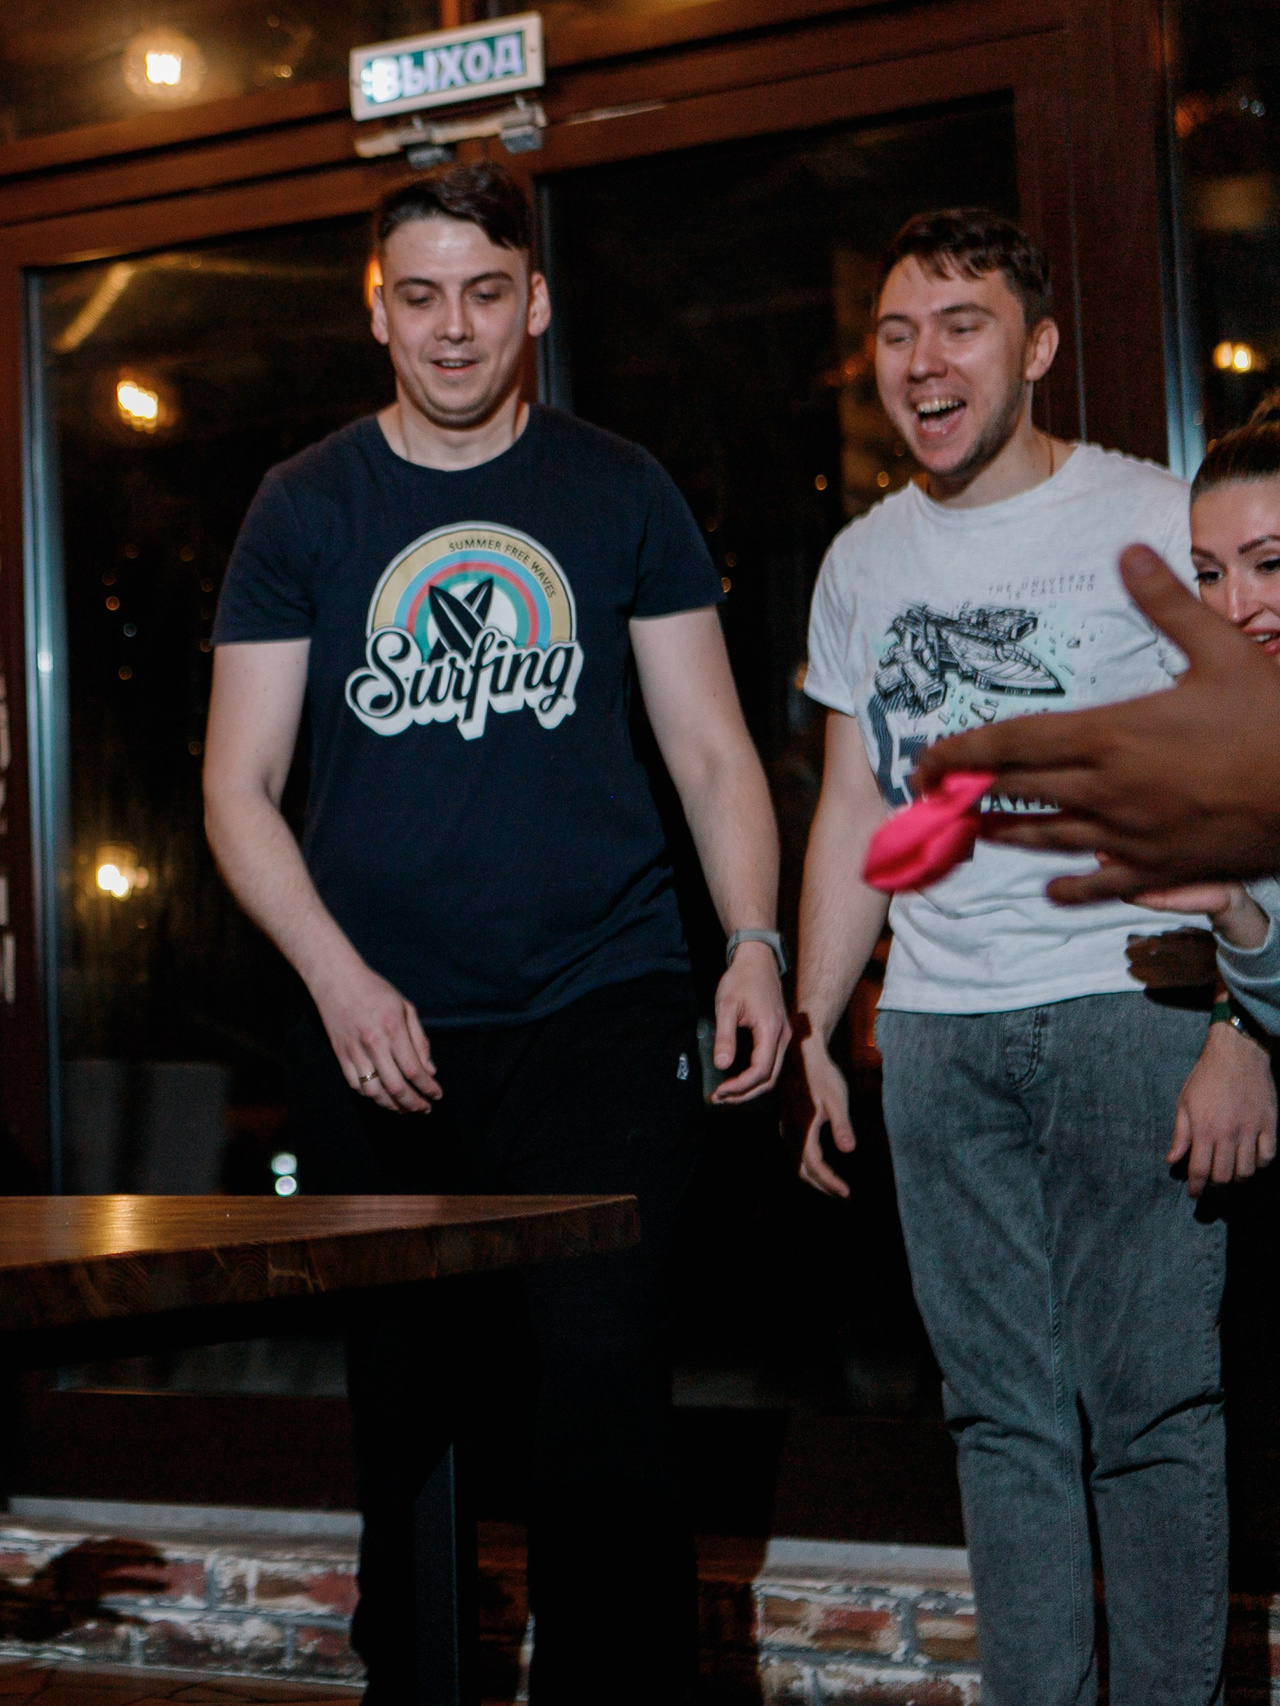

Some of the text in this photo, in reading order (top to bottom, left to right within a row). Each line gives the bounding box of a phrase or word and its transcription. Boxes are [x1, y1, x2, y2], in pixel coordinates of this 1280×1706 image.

[371, 33, 523, 103] ВЫХОД
[449, 539, 556, 598] SUMMER FREE WAVES
[988, 574, 1096, 595] THE UNIVERSE
[348, 629, 578, 725] Surfing
